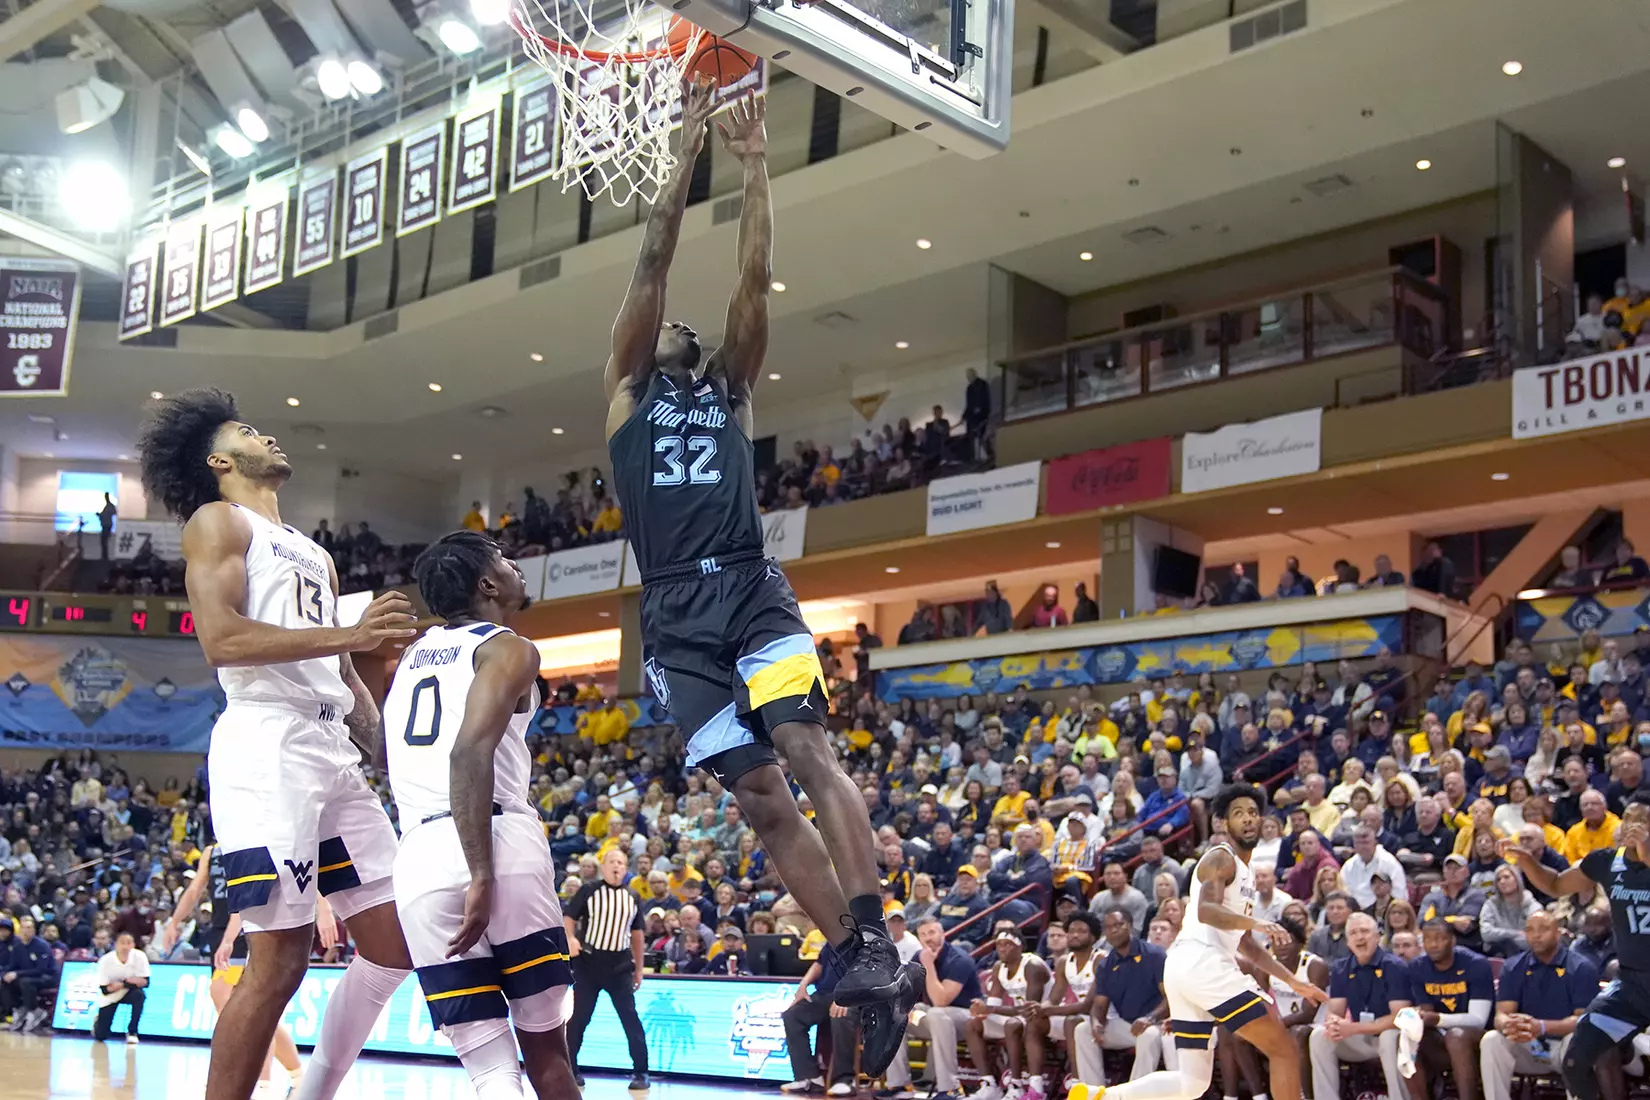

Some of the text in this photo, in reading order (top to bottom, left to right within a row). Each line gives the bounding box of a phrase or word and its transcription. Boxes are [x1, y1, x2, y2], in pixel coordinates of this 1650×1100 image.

[525, 121, 545, 155] 21
[463, 145, 486, 179] 42
[410, 168, 431, 204] 24
[353, 193, 374, 226] 10
[306, 213, 325, 244] 55
[4, 301, 64, 315] NATIONAL
[7, 331, 53, 349] 1983
[1518, 414, 1568, 431] GILL
[652, 435, 722, 486] 32
[1187, 451, 1239, 472] Explore
[954, 500, 982, 514] LIGHT
[700, 558, 721, 575] AL
[9, 598, 29, 626] 4
[294, 570, 324, 626] 13
[132, 612, 147, 631] 4
[409, 645, 462, 670] JOHNSON
[403, 674, 442, 746] 0
[1625, 904, 1650, 934] 12
